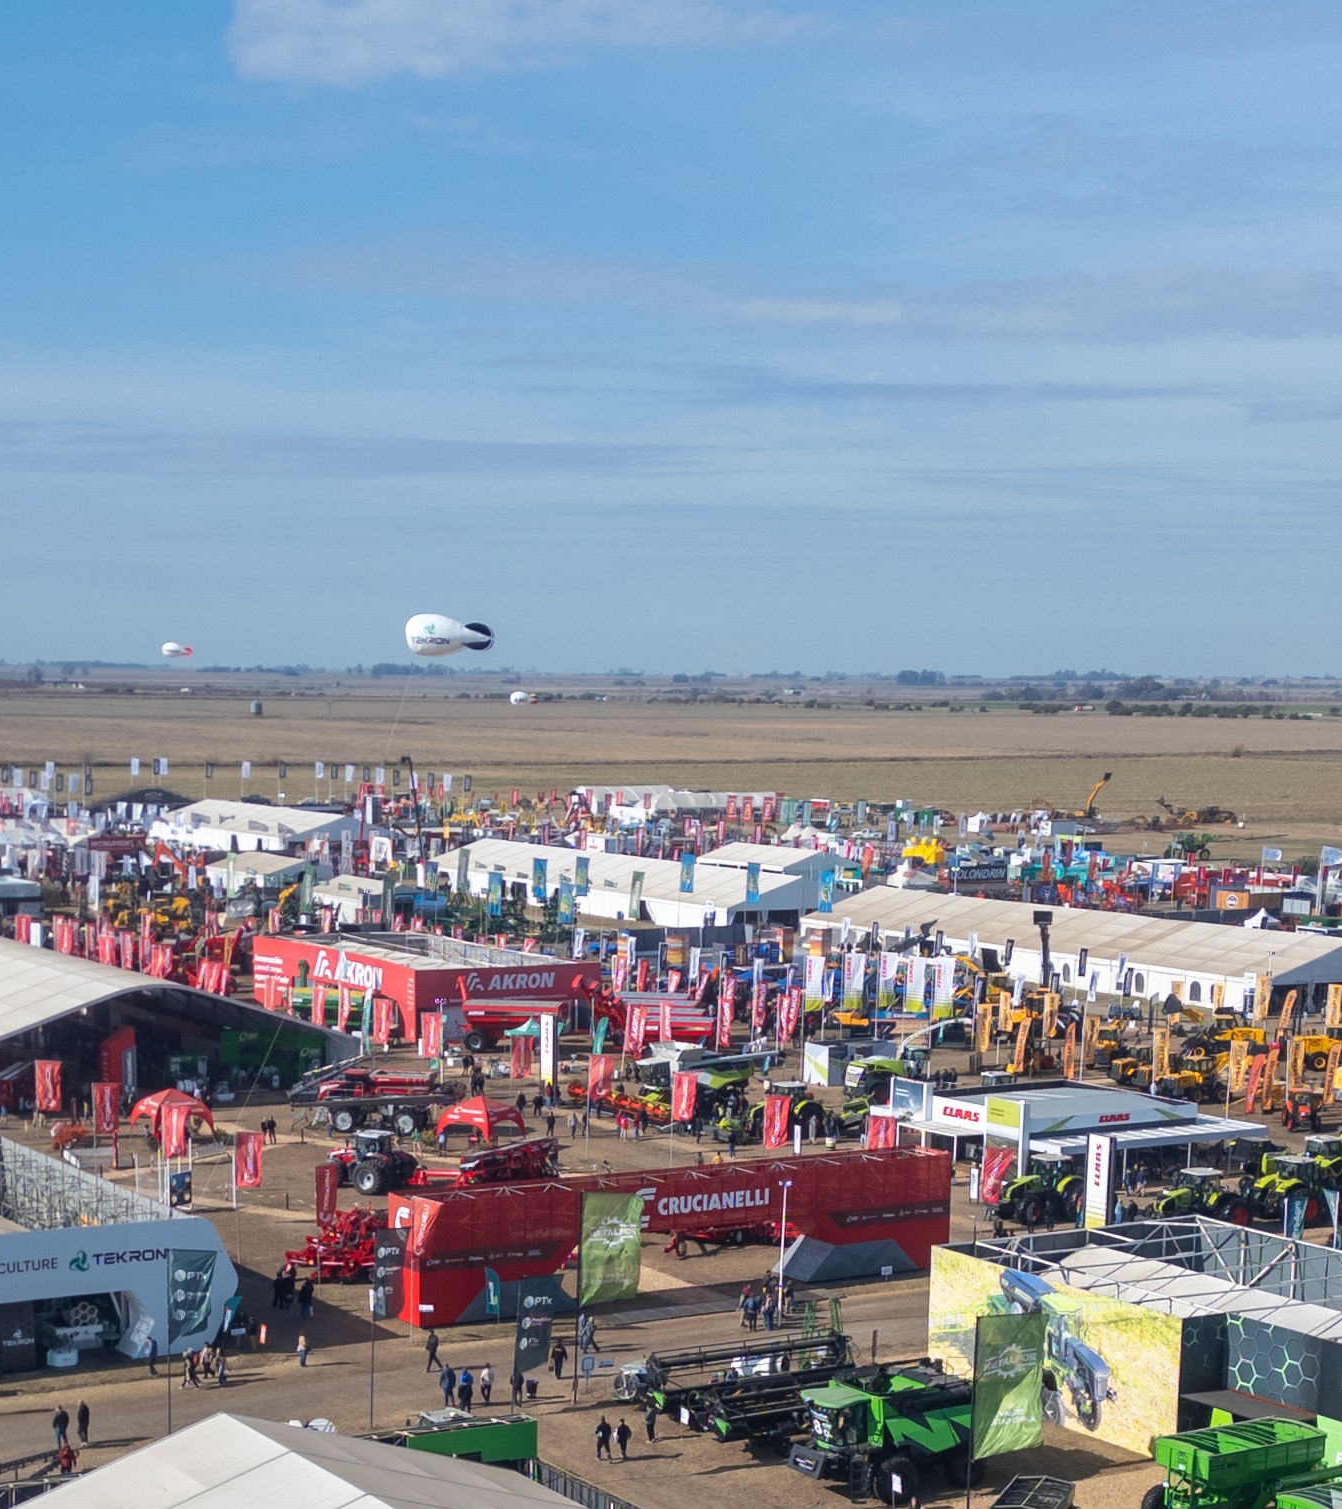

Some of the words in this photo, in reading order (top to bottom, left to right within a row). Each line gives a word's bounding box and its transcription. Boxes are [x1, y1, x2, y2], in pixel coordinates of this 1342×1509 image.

[487, 972, 556, 992] AKRON
[943, 1105, 980, 1123] CLAAS
[1099, 1113, 1131, 1124] CLAAS
[1094, 1143, 1102, 1187] CLAAS
[658, 1187, 771, 1216] CRUCIANELLI
[92, 1248, 170, 1266] TEKRON
[385, 1246, 400, 1256] PTx
[535, 1296, 553, 1307] PTx
[2, 1337, 35, 1346] TEKRON
